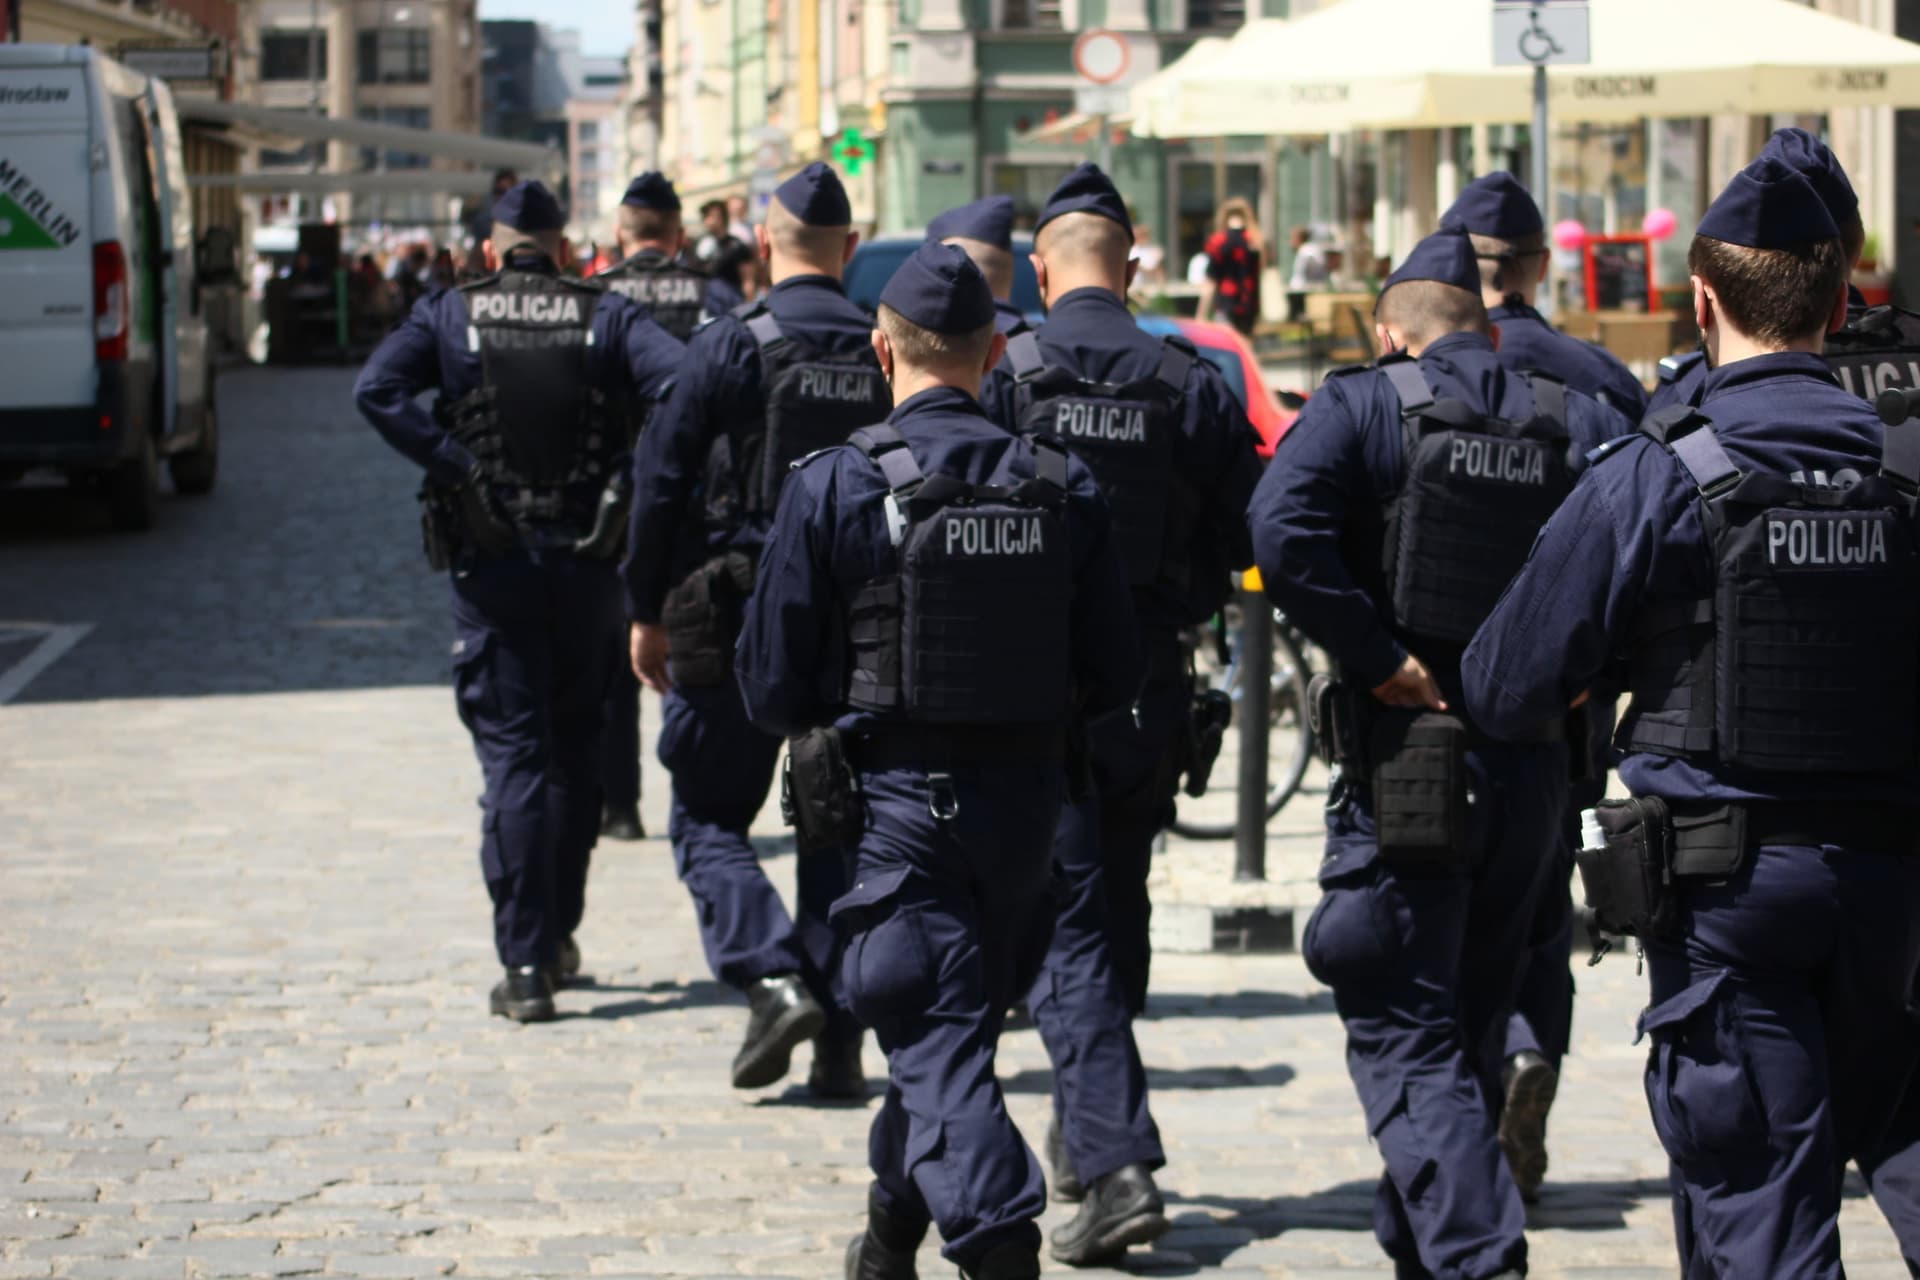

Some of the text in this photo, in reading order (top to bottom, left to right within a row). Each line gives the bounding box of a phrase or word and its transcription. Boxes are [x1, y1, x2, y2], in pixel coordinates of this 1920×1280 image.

[471, 294, 580, 322] POLICJA
[800, 368, 871, 402] POLICJA
[1056, 402, 1144, 442] POLICJA
[1449, 439, 1543, 485] POLICJA
[946, 517, 1043, 555] POLICJA
[1768, 519, 1887, 565] POLICJA
